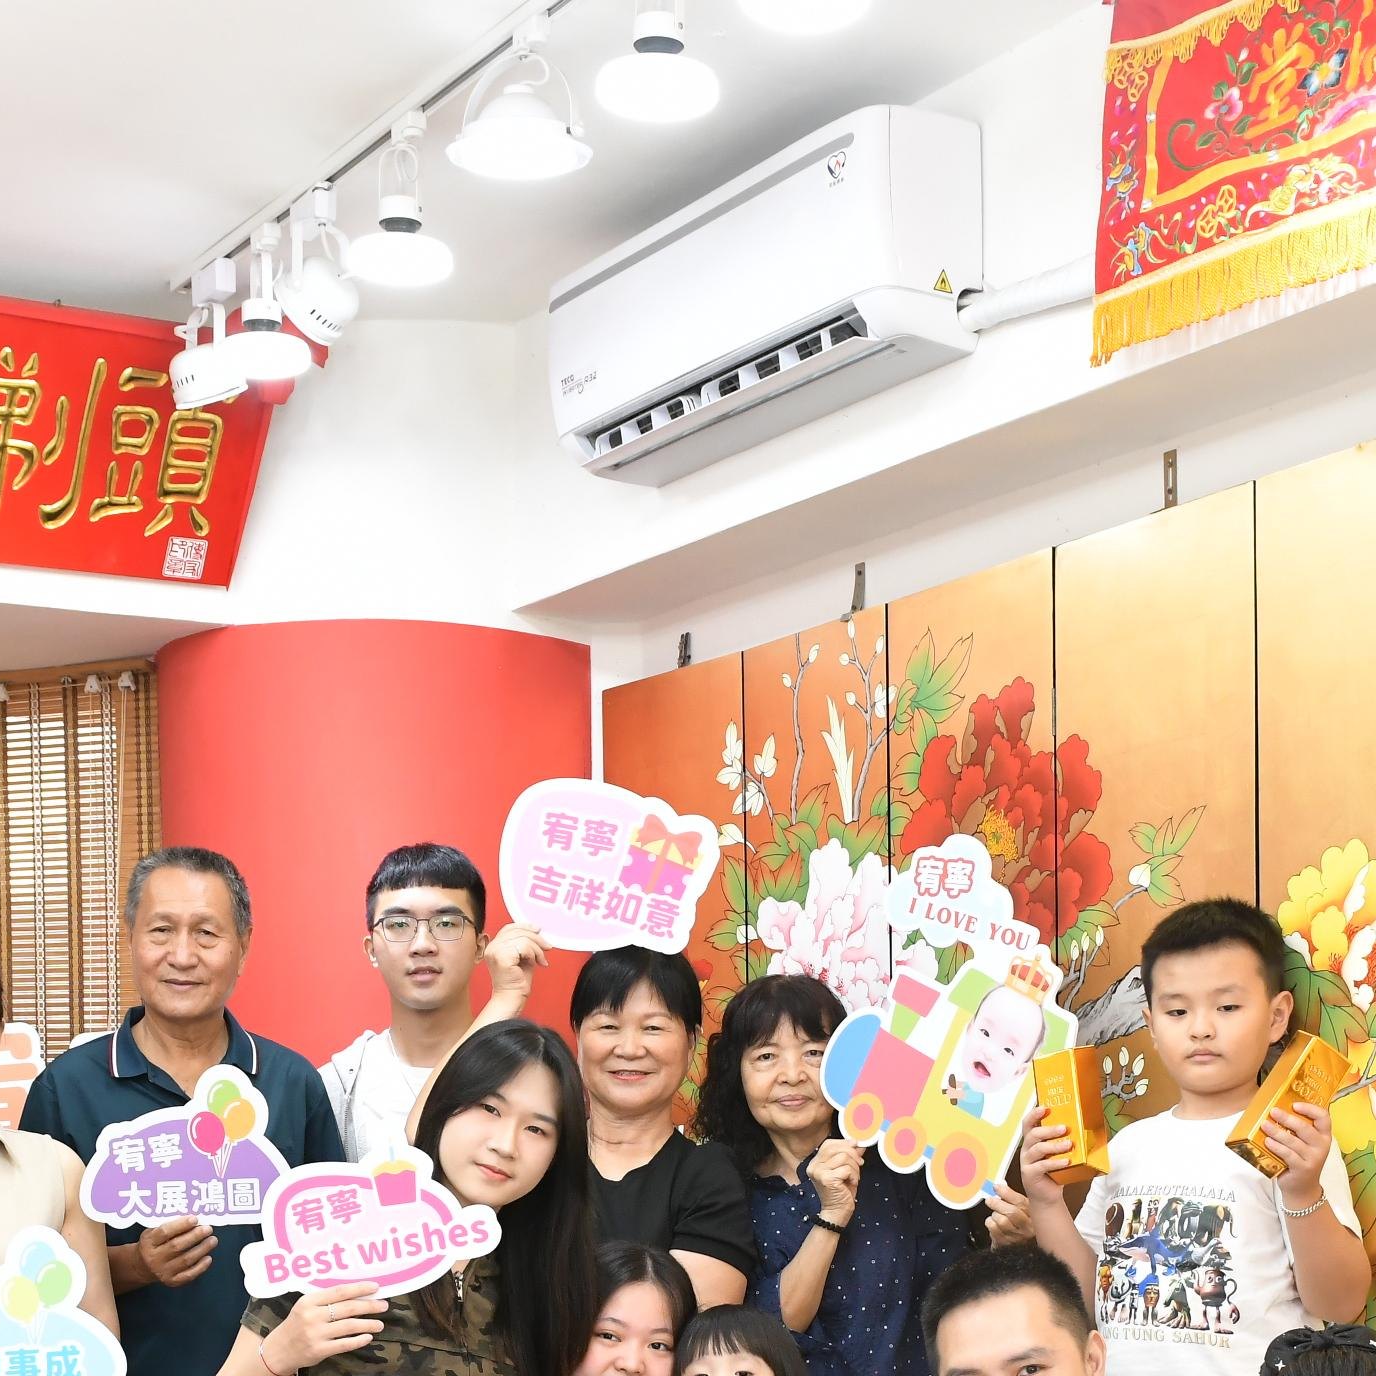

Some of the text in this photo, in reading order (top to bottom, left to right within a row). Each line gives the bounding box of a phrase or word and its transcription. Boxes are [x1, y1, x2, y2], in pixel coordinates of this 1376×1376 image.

[541, 812, 617, 857] 宥寧
[913, 855, 974, 898] 宥寧
[526, 864, 681, 941] 吉祥如意
[908, 897, 1032, 950] I LOVE YOU
[112, 1133, 184, 1174] 宥寧
[118, 1177, 261, 1217] 大展鴻圖
[291, 1184, 363, 1236] 宥寧
[264, 1215, 490, 1284] Best wishes
